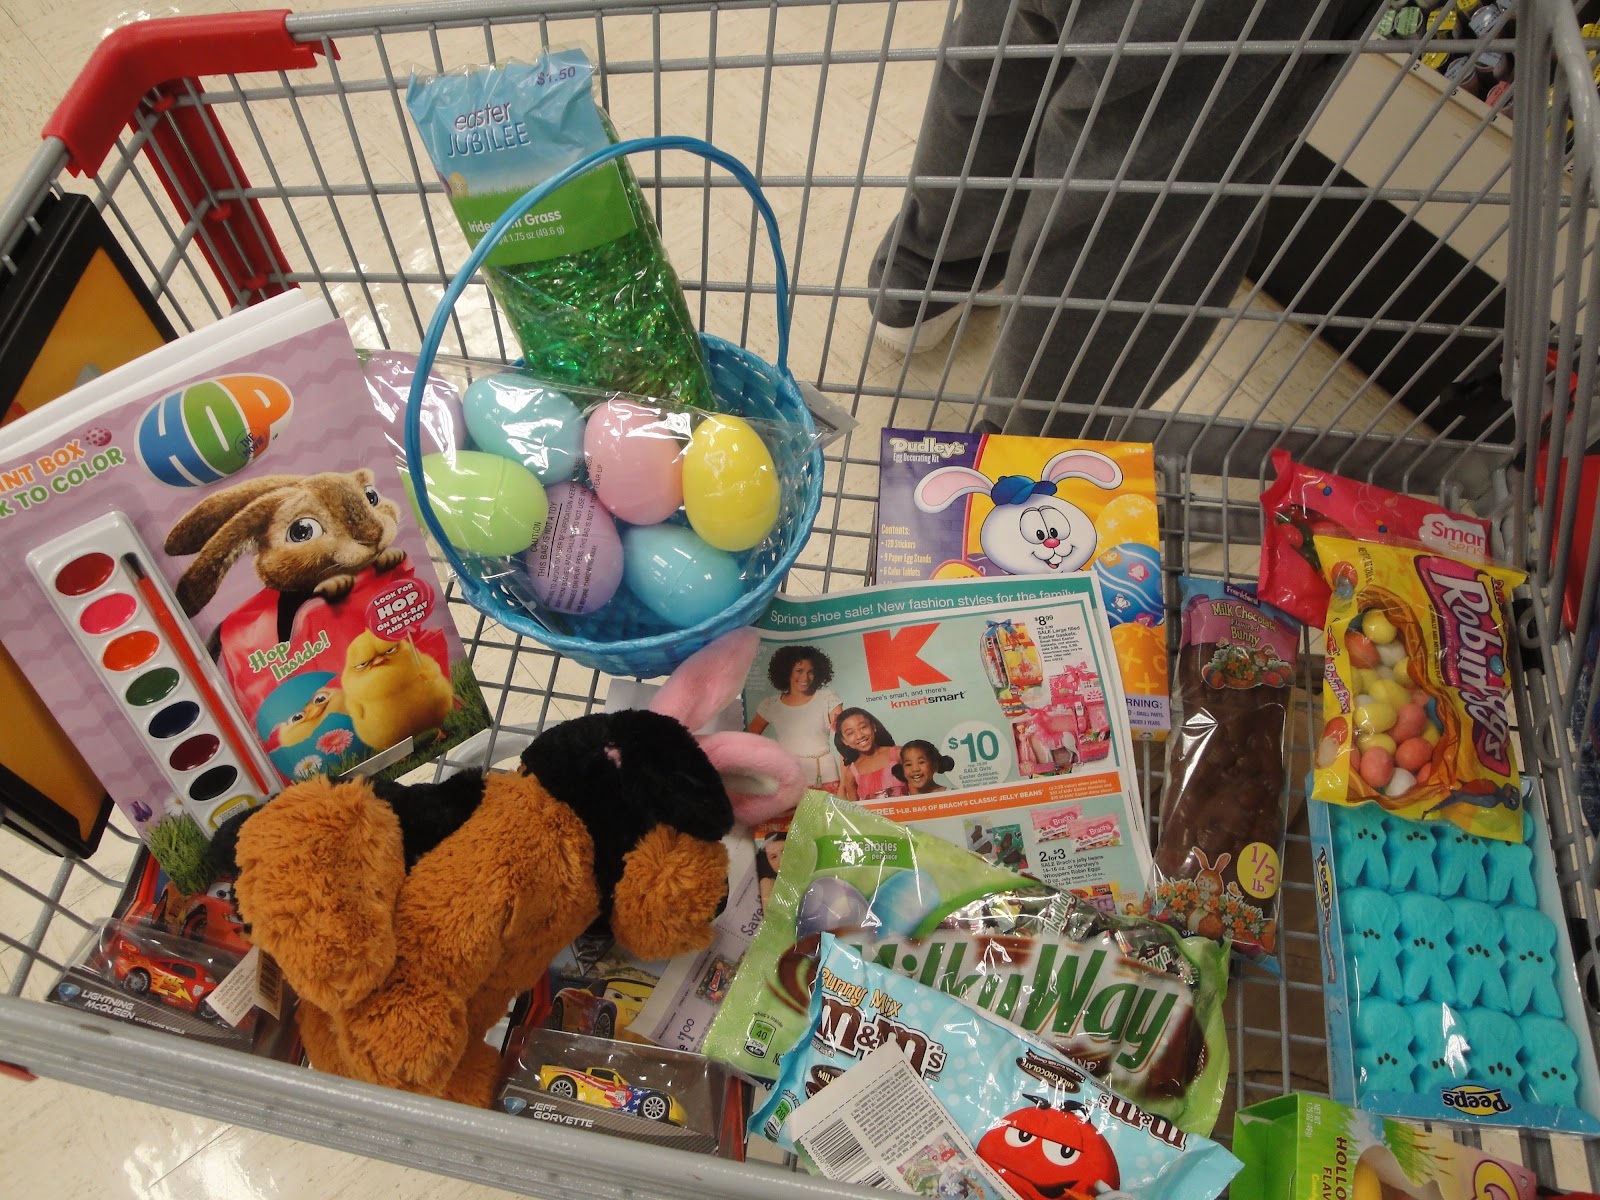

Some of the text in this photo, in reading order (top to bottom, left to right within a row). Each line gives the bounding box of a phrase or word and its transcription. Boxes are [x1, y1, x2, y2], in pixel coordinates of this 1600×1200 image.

[536, 66, 577, 86] $1.50
[454, 102, 511, 132] easter
[447, 122, 531, 158] JUBILEE
[524, 210, 562, 226] Grass
[509, 232, 525, 242] 1.75
[135, 373, 294, 489] HOP
[240, 432, 254, 448] THE
[889, 437, 966, 458] Dudley's
[0, 439, 87, 494] INT BOX
[893, 453, 902, 462] Egg
[903, 454, 930, 464] Decorating
[13, 491, 49, 511] TO
[50, 447, 127, 496] COLOR
[548, 501, 557, 515] TOY
[530, 521, 542, 553] CAUTION
[544, 520, 553, 534] NOT
[882, 524, 910, 535] Contents:
[541, 543, 549, 559] BAG
[895, 540, 915, 548] Stickers
[889, 553, 903, 563] Paper
[904, 553, 913, 564] Egg
[914, 554, 931, 563] Stands
[537, 562, 547, 577] THIS
[888, 567, 901, 576] Color
[903, 568, 920, 576] Tablets
[373, 583, 413, 606] LOOK FOR
[1225, 584, 1260, 605] Frankford
[377, 591, 419, 620] HOP
[377, 601, 428, 631] ON BLU-RAY
[770, 610, 808, 627] Spring
[810, 603, 842, 623] shoe
[843, 601, 875, 618] sale!
[876, 600, 907, 614] New
[908, 594, 957, 612] fashion
[958, 591, 995, 610] styles
[996, 589, 1014, 602] for
[1016, 589, 1037, 602] the
[387, 611, 425, 635] AND DVD!
[1211, 602, 1278, 633] Milk Chocolate
[1231, 626, 1261, 647] Bunny
[1430, 571, 1503, 690] Robin
[248, 641, 290, 672] Hop
[271, 630, 331, 681] Inside!
[862, 622, 954, 693] K
[866, 686, 948, 703] there's smart, and there's
[890, 690, 966, 709] kmartsmart
[948, 729, 999, 764] $10
[939, 800, 968, 810] BRACH'S
[969, 796, 997, 806] CLASSIC
[999, 793, 1017, 803] JELLY
[1039, 851, 1047, 862] 2
[1251, 845, 1276, 885] 1/2
[1252, 877, 1268, 895] lb.
[1311, 846, 1338, 923] Peeps
[163, 976, 185, 991] 95
[81, 990, 135, 1010] LIGHTNING
[84, 1000, 136, 1020] McQUEEN
[869, 989, 902, 1017] Mix
[756, 1031, 767, 1041] 40
[1022, 1058, 1058, 1081] CHOCOLATE
[529, 1101, 558, 1112] JEFF
[1441, 1090, 1512, 1113] Peeps
[533, 1110, 595, 1128] GORVETTE
[1100, 1093, 1189, 1152] m&m's
